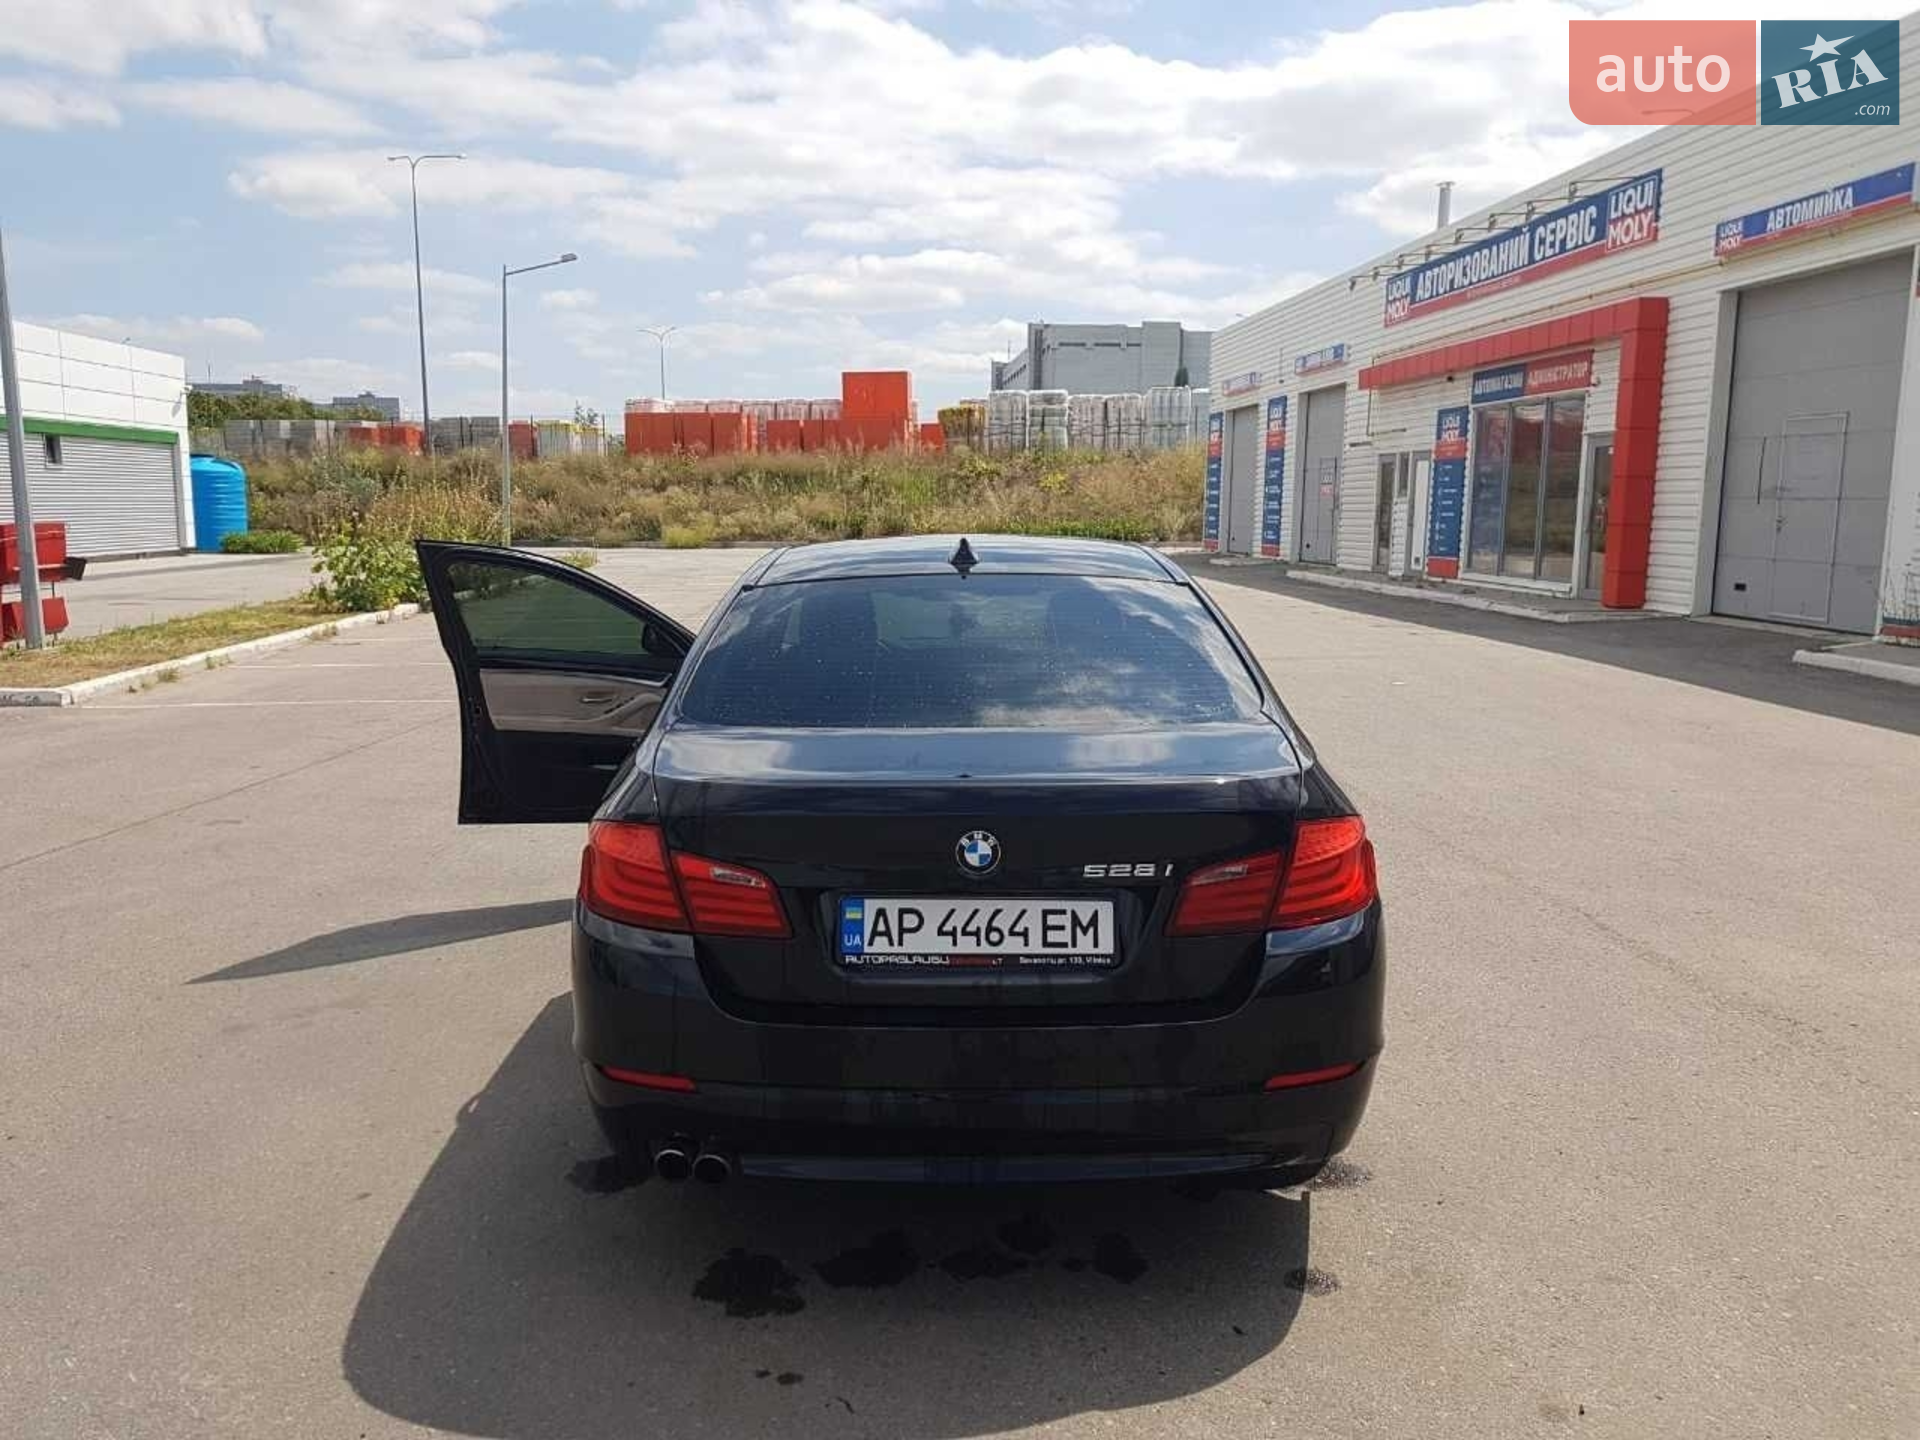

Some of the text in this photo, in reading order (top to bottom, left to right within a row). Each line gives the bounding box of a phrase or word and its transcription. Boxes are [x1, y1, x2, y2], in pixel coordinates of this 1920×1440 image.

[1611, 180, 1655, 219] LIQUI
[1766, 187, 1854, 232] АВТОМИЙКА
[1607, 211, 1652, 250] MOLY
[1415, 205, 1598, 302] АВТОРИЗОВАНИЙ СЕРВІС
[1388, 275, 1411, 300] LIQUI
[1386, 298, 1411, 321] MOLY
[844, 934, 862, 947] UA
[867, 908, 1099, 948] AP 4464 EM
